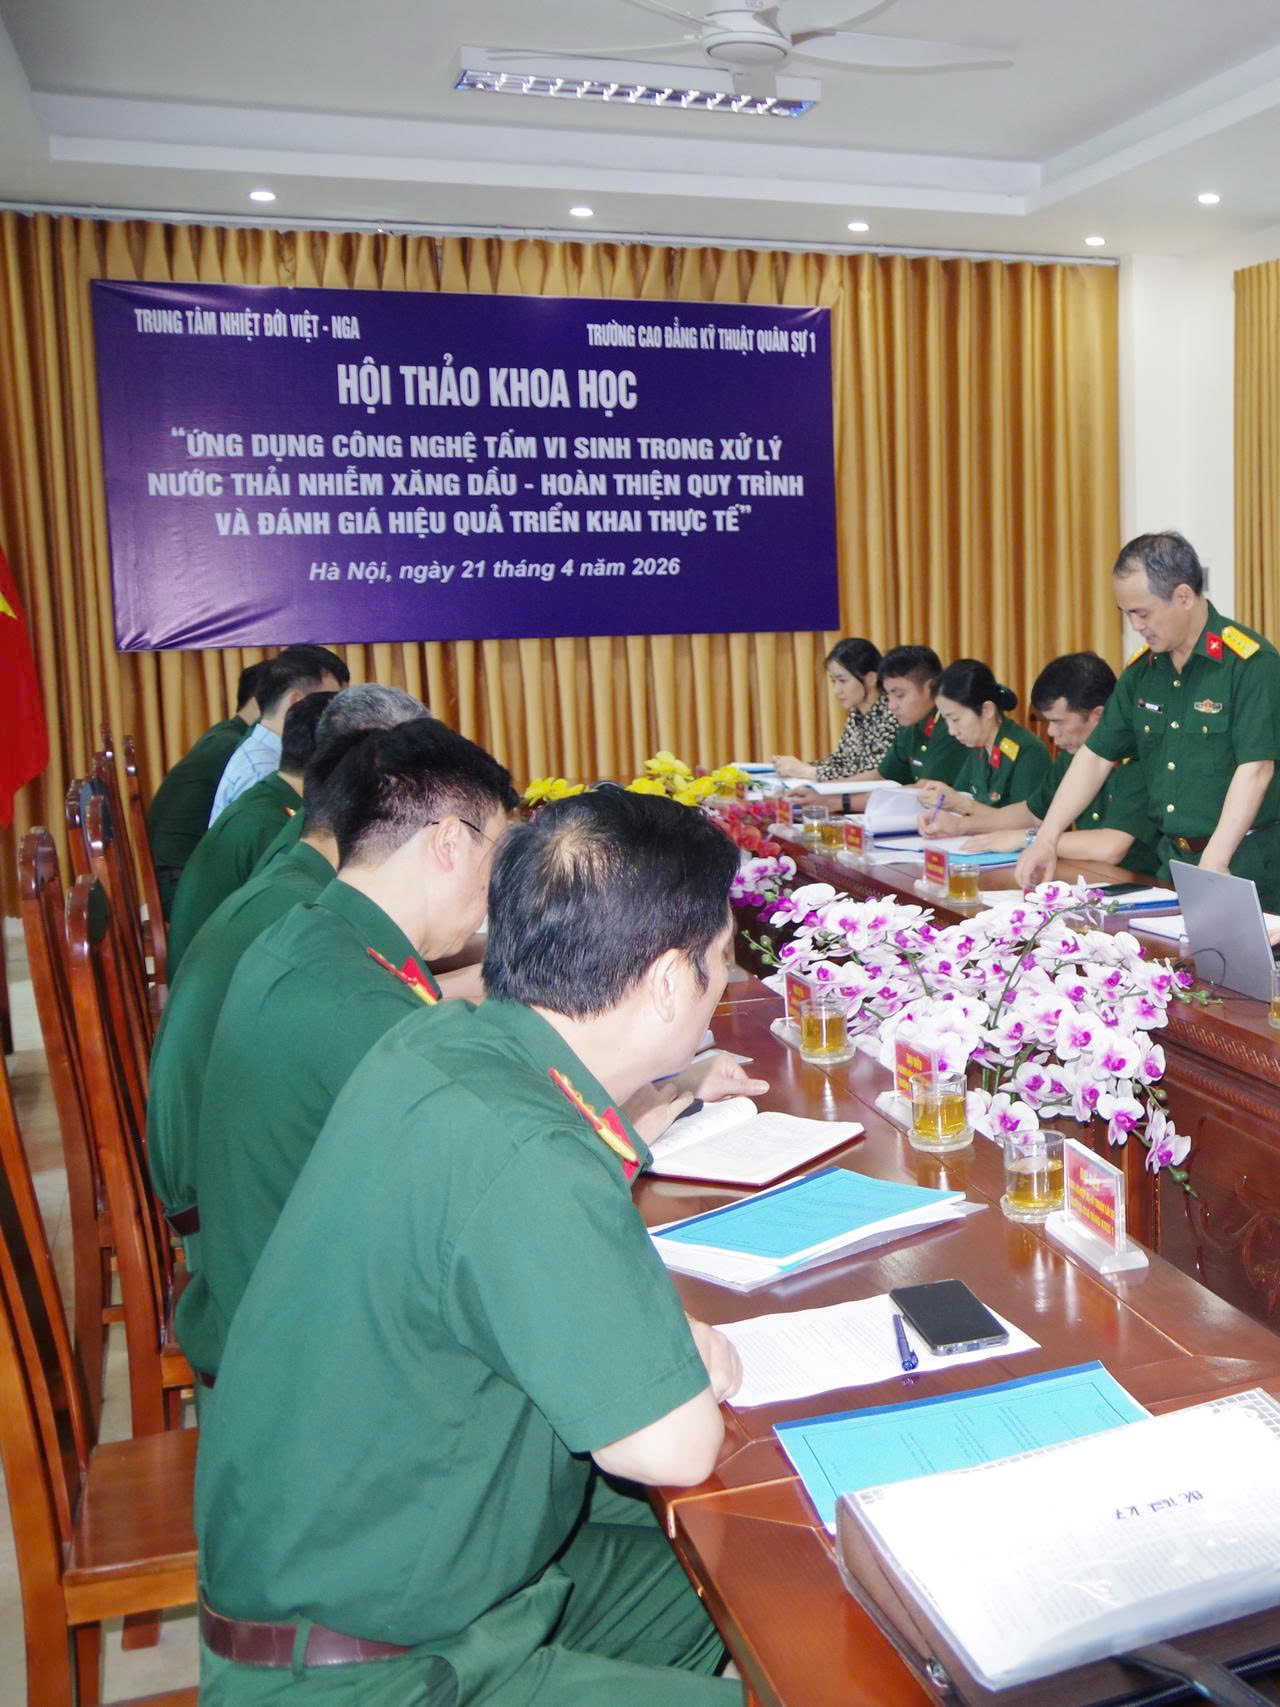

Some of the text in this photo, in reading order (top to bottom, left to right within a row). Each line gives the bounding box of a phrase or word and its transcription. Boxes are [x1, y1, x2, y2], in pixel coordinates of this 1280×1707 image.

[135, 309, 183, 334] TRUNG
[186, 306, 217, 335] TÂM
[220, 308, 260, 341] NHIỆT
[264, 309, 287, 337] ĐỚI
[290, 311, 319, 342] VIỆT
[332, 316, 360, 339] NGA
[587, 317, 815, 357] TRƯỜNG CAO ĐẲNG KỸ THUẬT QUÂN SỰ 1
[338, 353, 637, 417] HỘI THẢO KHOA HỌC
[252, 433, 324, 462] DỤNG
[332, 429, 402, 457] CÔNG
[411, 432, 477, 462] NGHỆ
[484, 429, 536, 458] TẤM
[544, 437, 566, 458] VI
[574, 437, 631, 458] SINH
[637, 438, 713, 459] TRONG
[720, 432, 752, 460] XỬ
[757, 431, 781, 460] LÝ
[148, 468, 224, 498] NƯỚC
[230, 466, 290, 496] THẢI
[299, 466, 383, 496] NHIỄM
[392, 467, 460, 495] XĂNG
[468, 467, 516, 495] DẦU
[541, 470, 606, 497] HOÀN
[613, 470, 680, 500] THIỆN
[688, 474, 731, 497] QUY
[736, 471, 803, 497] TRÌNH
[214, 507, 251, 536] VÀ
[257, 507, 330, 536] ĐÁNH
[338, 507, 382, 534] GIÁ
[389, 507, 445, 538] HIỆU
[454, 504, 503, 535] QUẢ
[510, 502, 579, 532] TRIỂN
[587, 511, 641, 532] KHAI
[648, 509, 706, 536] THỰC
[309, 558, 680, 584] Hà Nội, ngày 21 tháng 4 năm 2026
